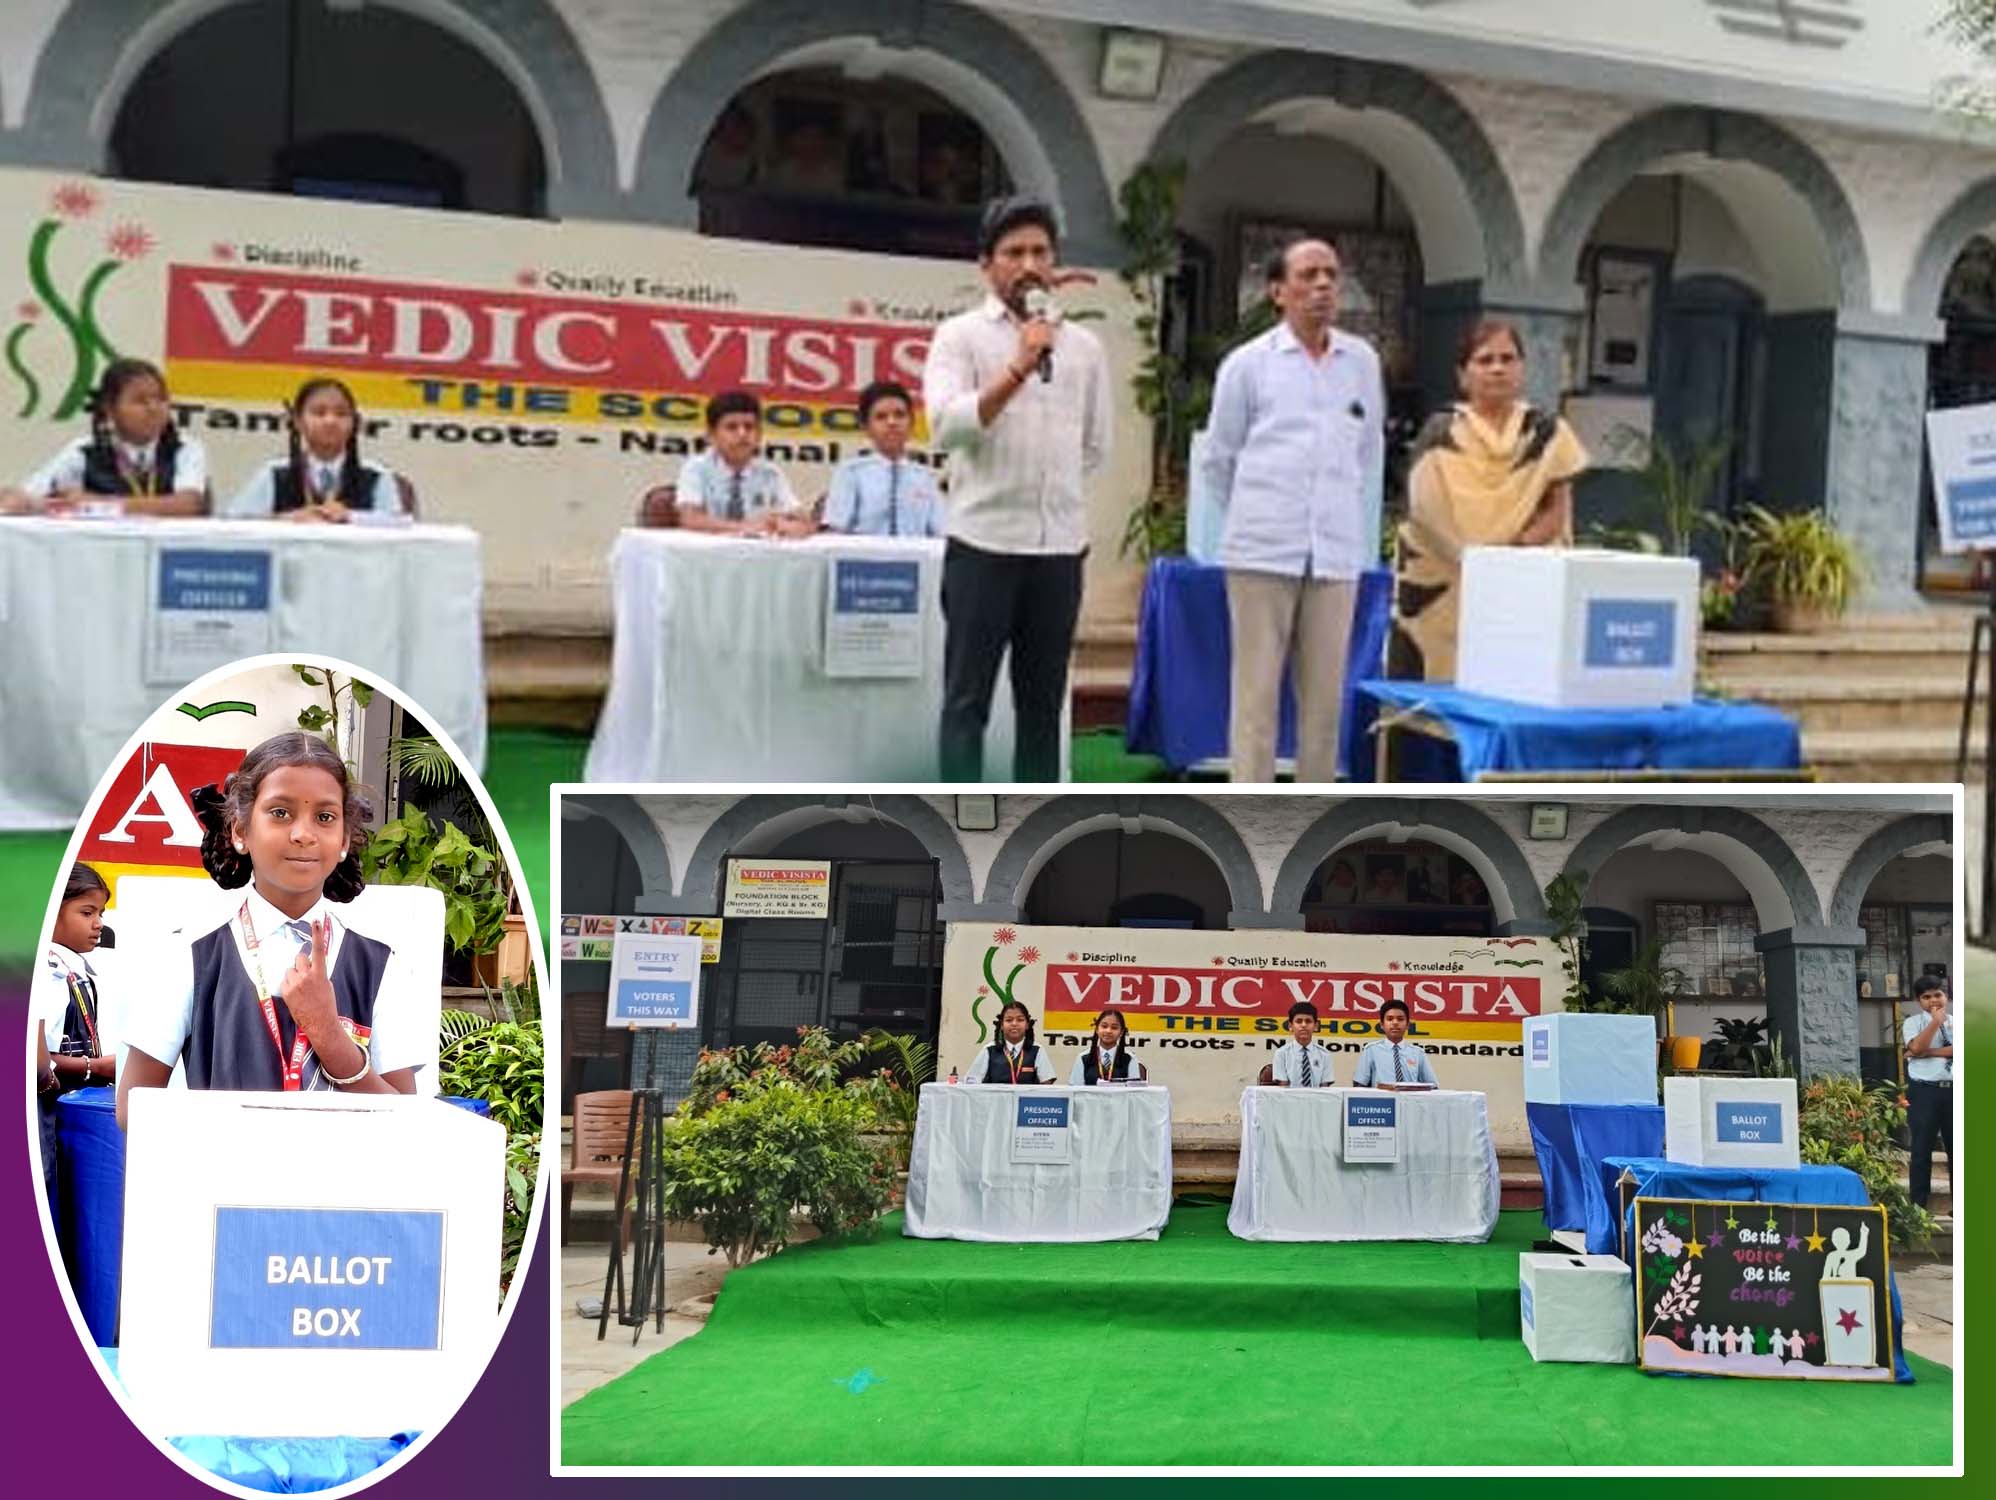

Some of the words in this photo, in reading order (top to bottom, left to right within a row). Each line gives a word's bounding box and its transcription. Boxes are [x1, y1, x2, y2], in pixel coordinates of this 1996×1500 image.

[245, 243, 362, 274] Discipline
[193, 281, 617, 374] VEDIC
[651, 319, 934, 399] VISIS
[406, 377, 570, 414] THE
[171, 402, 392, 440] Tanr
[408, 422, 559, 449] roots
[743, 870, 779, 880] VEDIC
[782, 871, 825, 880] VISISTA
[584, 918, 600, 934] W
[620, 919, 634, 933] X
[633, 951, 680, 962] ENTRY
[1082, 951, 1137, 965] Discipline
[1227, 955, 1269, 969] Quality
[1272, 957, 1327, 969] Education
[1403, 961, 1465, 973] Knowledge
[633, 992, 675, 1001] VOTERS
[1058, 972, 1264, 1009] VEDIC
[1281, 978, 1531, 1016] VISISTA
[627, 1006, 651, 1015] THIS
[653, 1006, 680, 1015] WAY
[1158, 1015, 1240, 1031] THE
[1160, 1036, 1236, 1050] roots
[1023, 1106, 1063, 1114] PRESIDING
[1351, 1106, 1392, 1114] RETURNING
[1358, 1117, 1386, 1125] OFFICER
[1731, 1115, 1768, 1125] BALLOT
[1740, 1130, 1761, 1140] BOX
[1739, 1228, 1758, 1243] Be
[1760, 1228, 1781, 1244] the
[266, 1254, 392, 1286] BALLOT
[1743, 1266, 1765, 1281] Be
[1768, 1265, 1791, 1282] the
[292, 1307, 362, 1338] BOX
